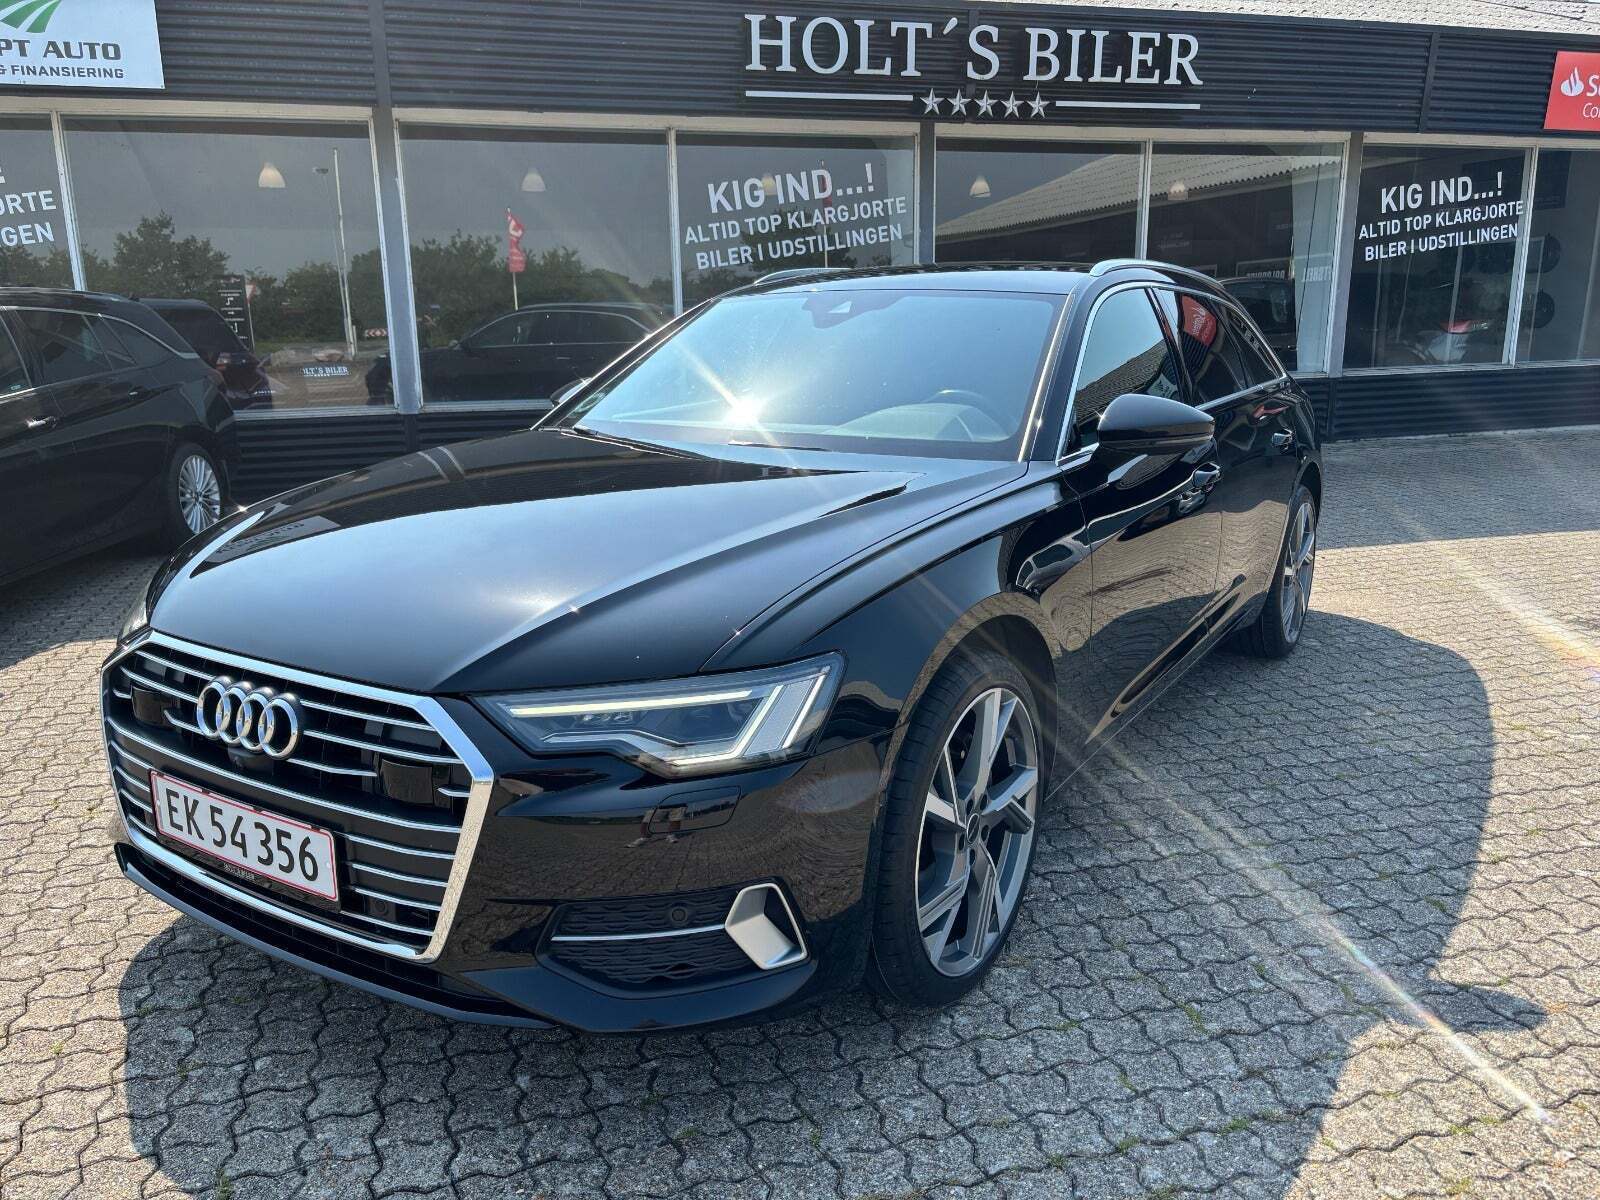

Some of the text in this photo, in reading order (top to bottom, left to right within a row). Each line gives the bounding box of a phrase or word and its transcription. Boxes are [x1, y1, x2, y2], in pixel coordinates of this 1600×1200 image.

[12, 65, 124, 79] FINANSIERING
[43, 40, 121, 60] AUTO
[1023, 27, 1203, 86] BILER
[707, 163, 875, 214] KIG IND...!
[1381, 171, 1503, 214] KIG IND...!
[685, 196, 907, 244] ALTID TOP KLARGJORTE
[1358, 200, 1524, 240] ALTID TOP KLARGJORTE
[1365, 223, 1519, 261] BILER I UDSTILLINGEN
[696, 223, 903, 270] BILER I UDSTILLINGEN
[165, 787, 204, 841] EK
